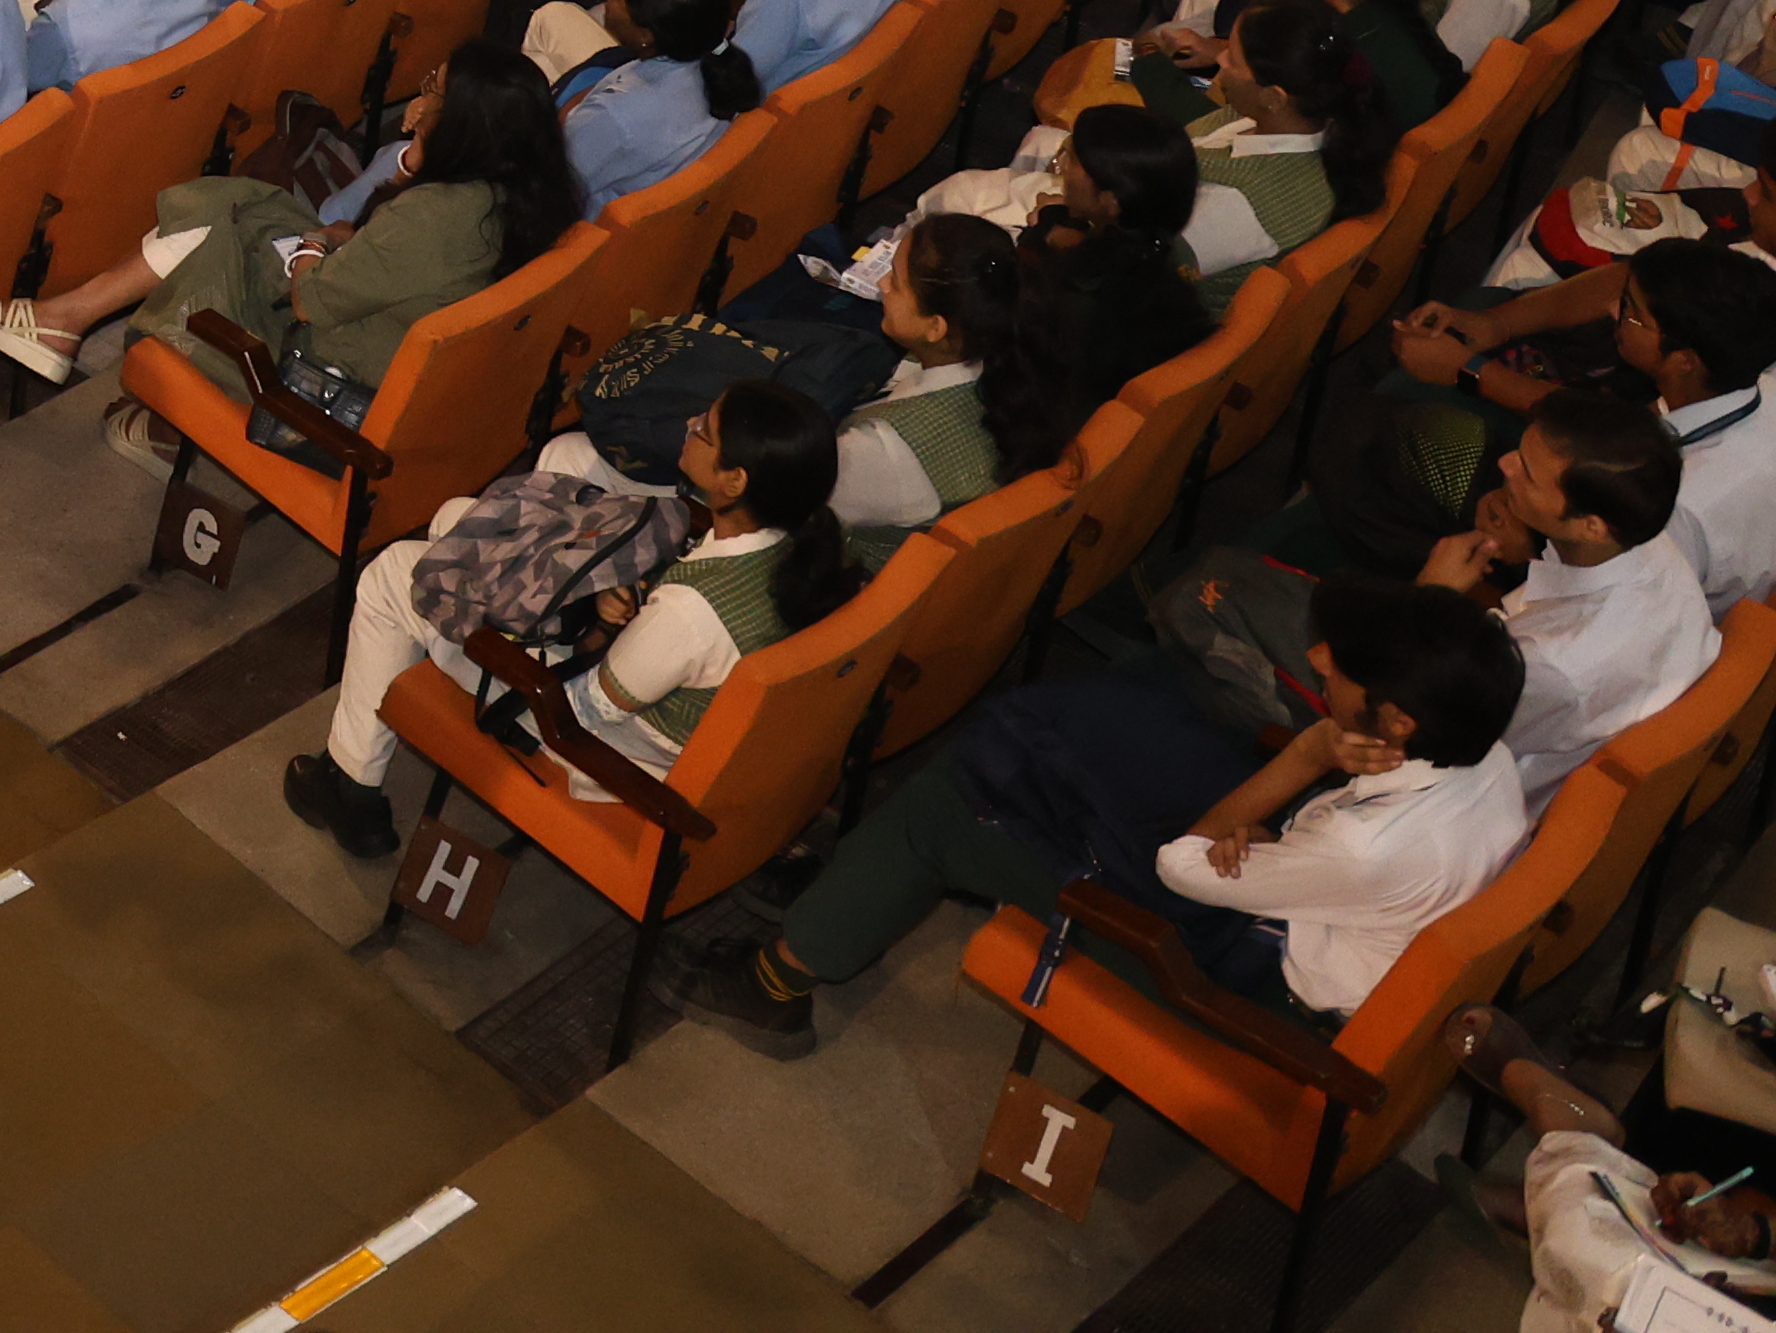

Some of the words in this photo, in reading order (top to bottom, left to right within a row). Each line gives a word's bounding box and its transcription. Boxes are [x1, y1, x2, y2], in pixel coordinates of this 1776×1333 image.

[181, 507, 221, 567] G
[416, 840, 481, 921] H
[1021, 1103, 1077, 1188] I
